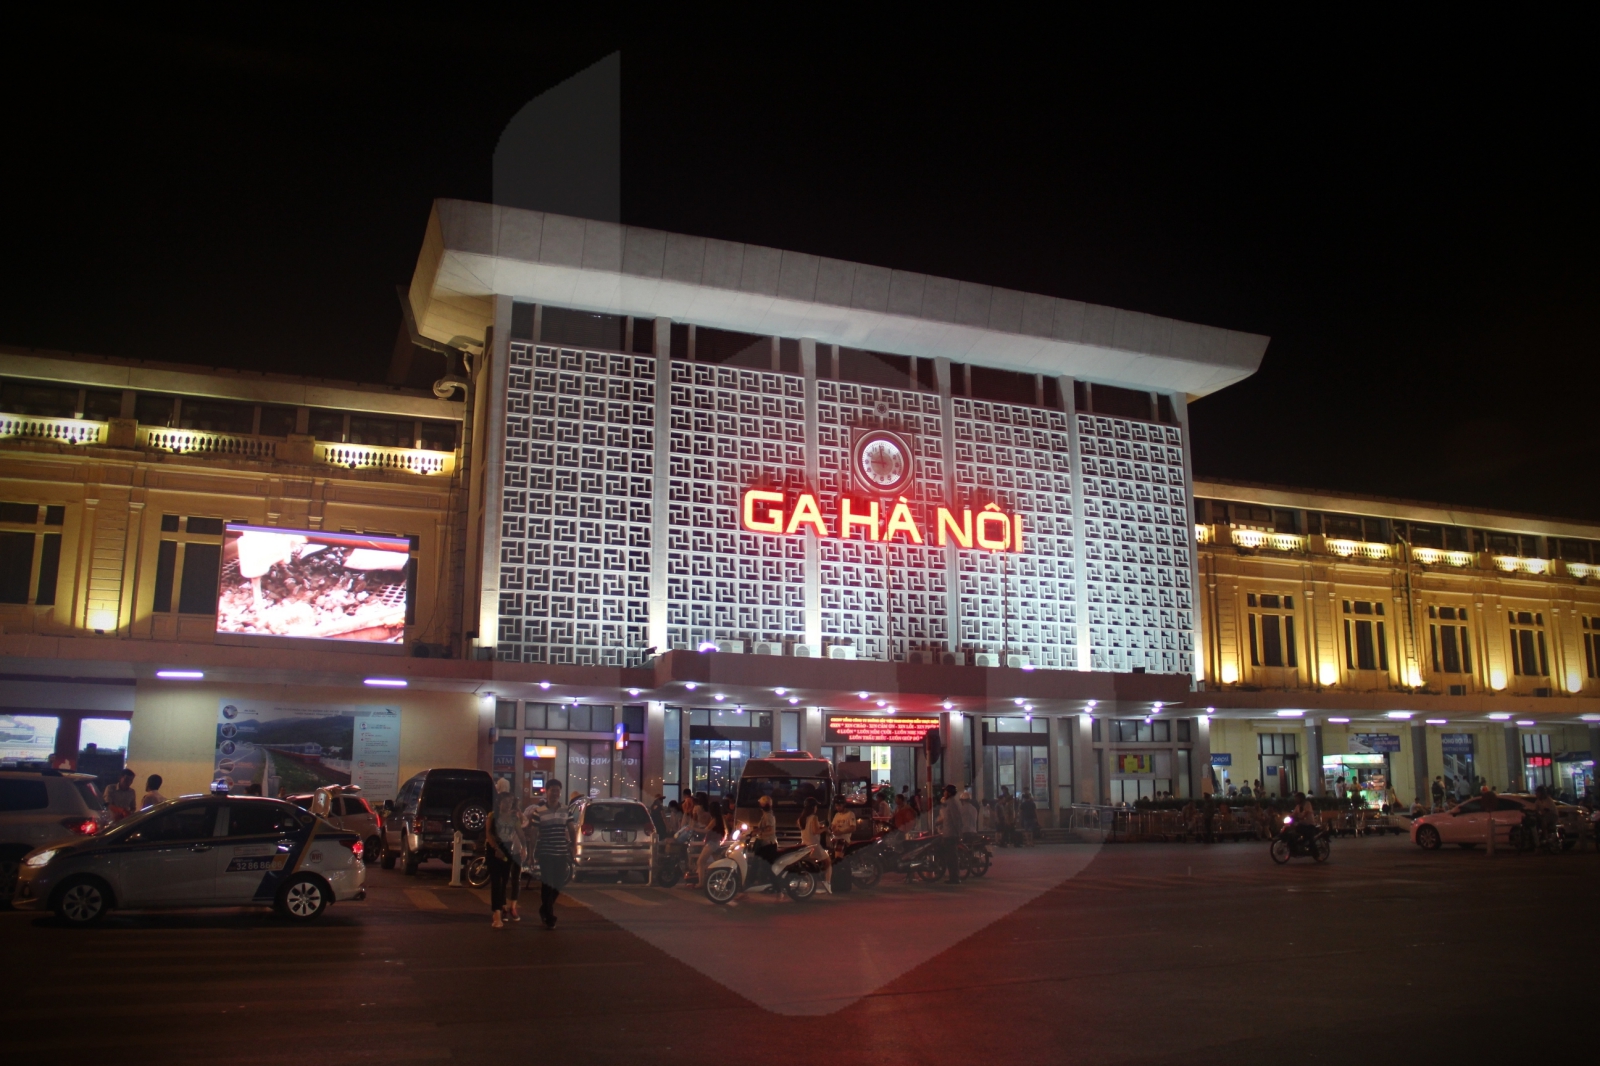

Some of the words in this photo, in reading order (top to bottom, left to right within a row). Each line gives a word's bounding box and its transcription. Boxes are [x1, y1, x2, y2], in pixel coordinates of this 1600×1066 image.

[744, 490, 829, 535] GA
[840, 496, 923, 544] HÀ
[937, 502, 1022, 554] NỘI
